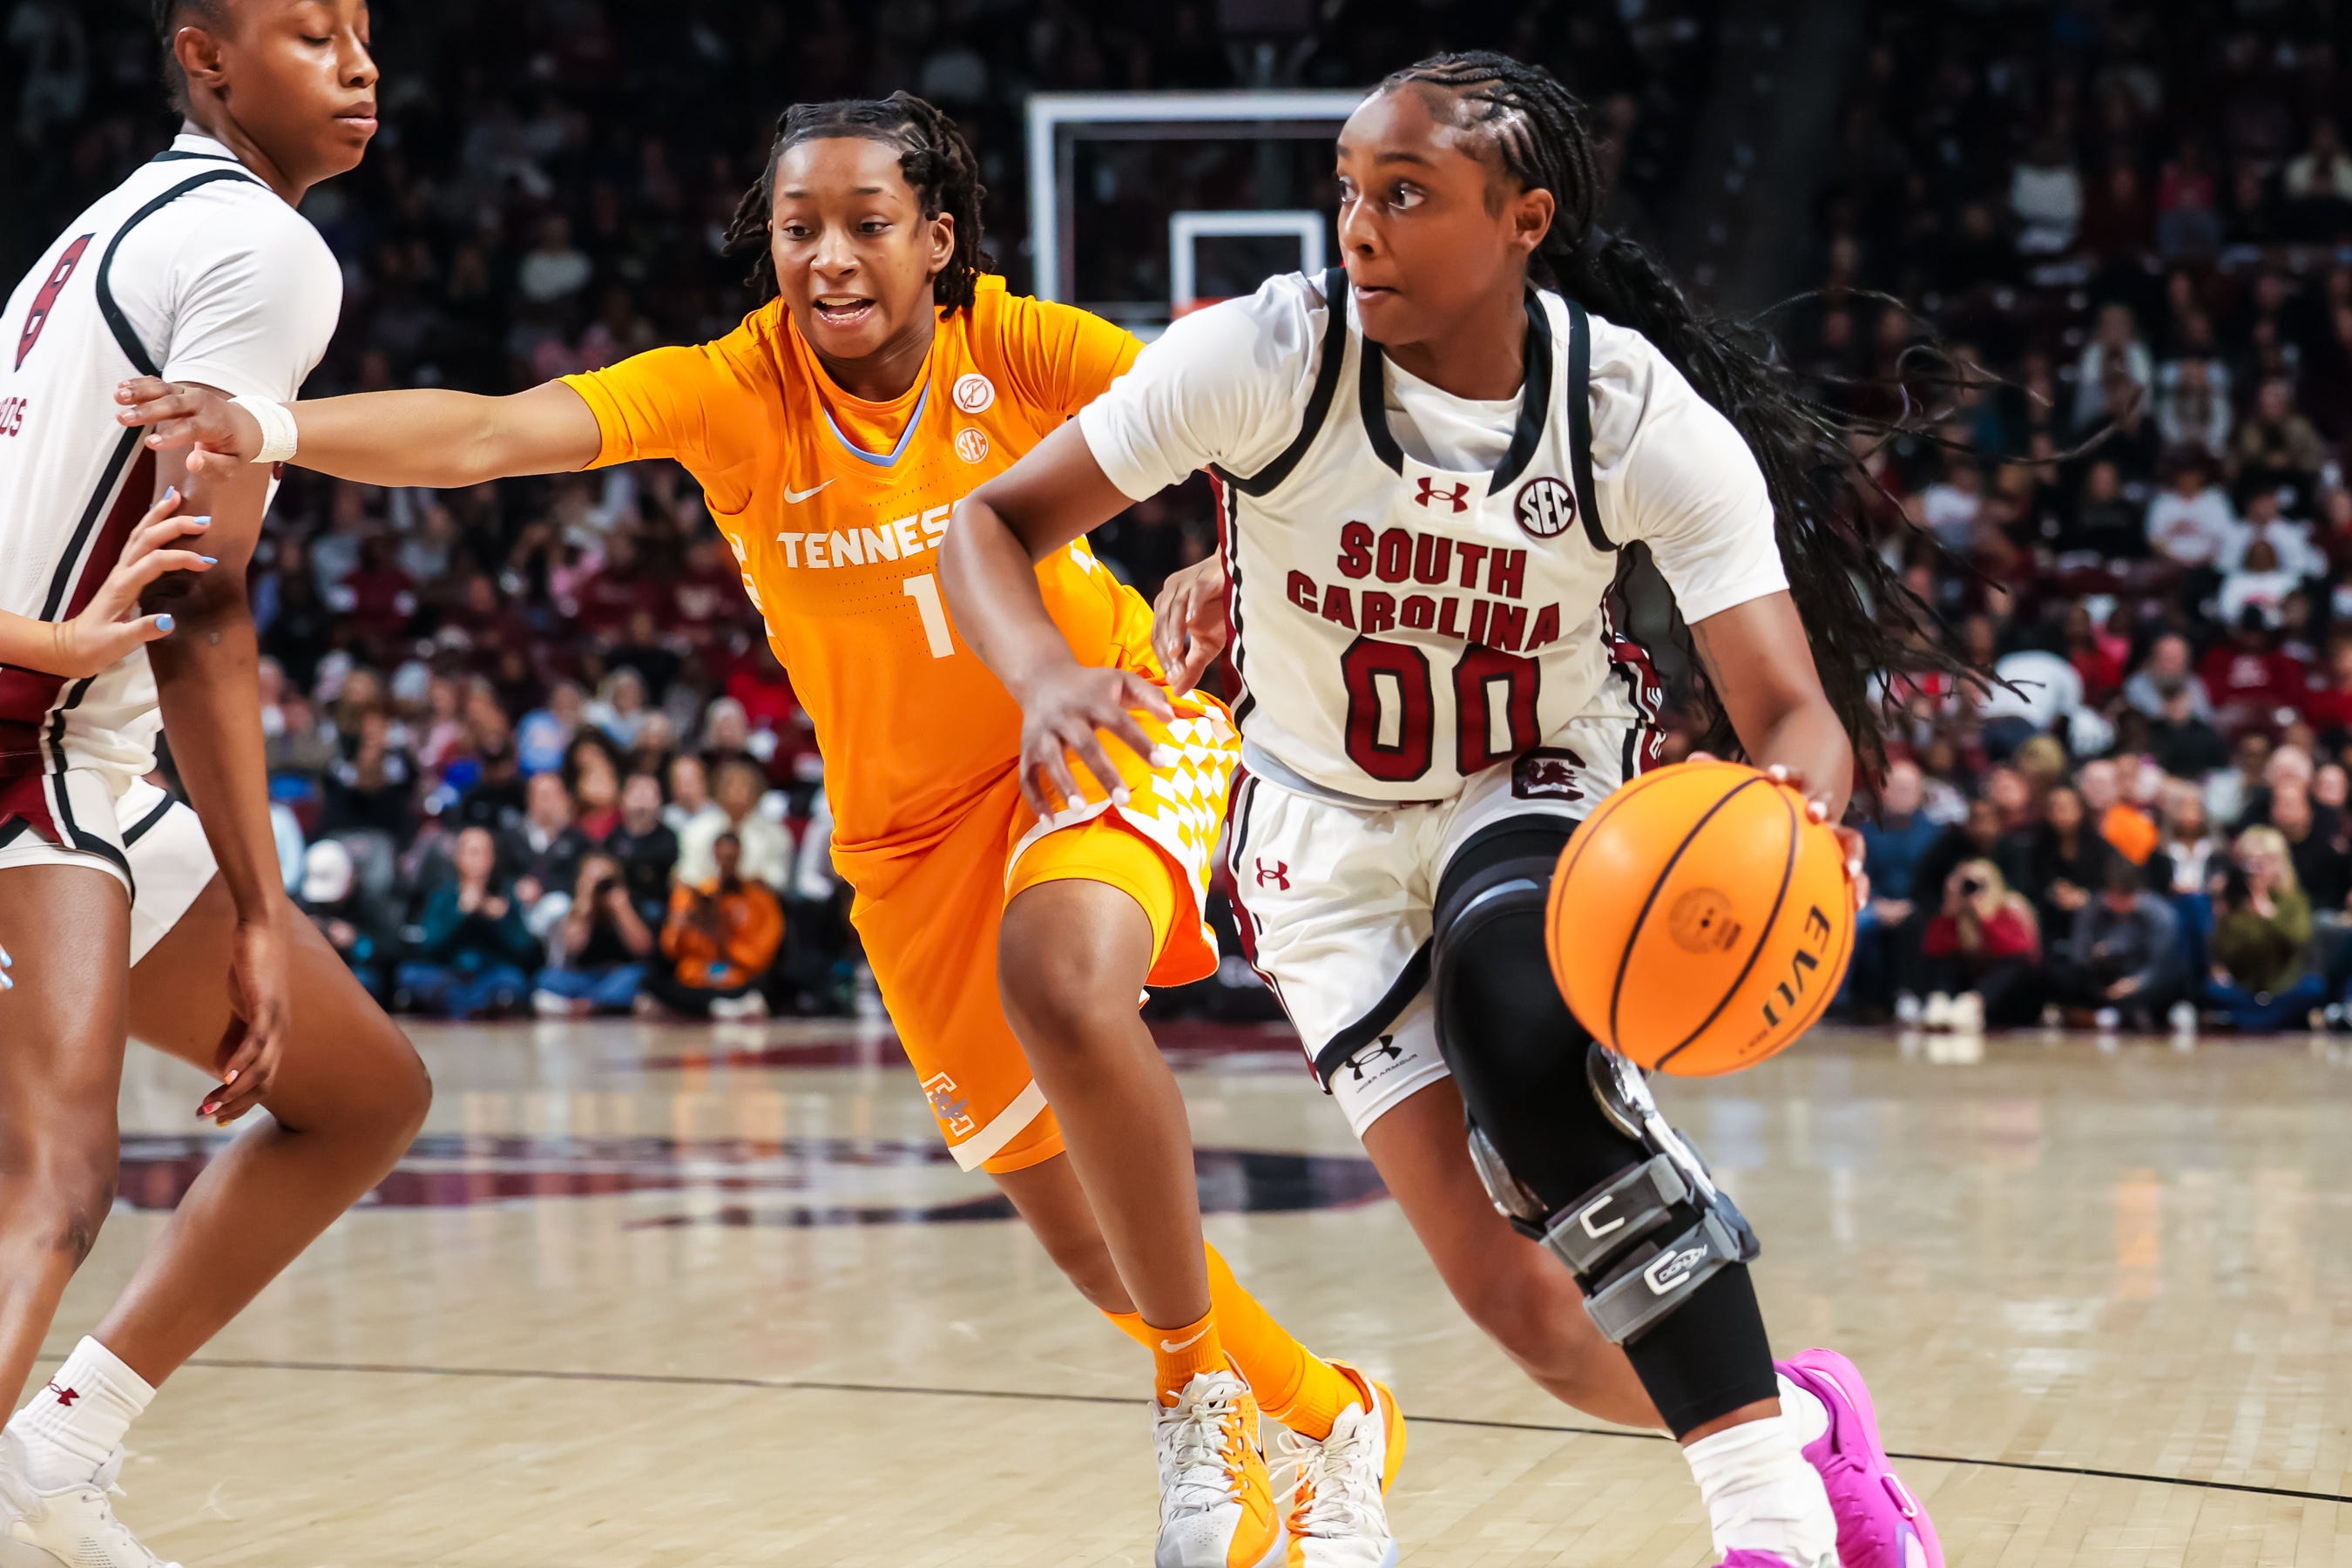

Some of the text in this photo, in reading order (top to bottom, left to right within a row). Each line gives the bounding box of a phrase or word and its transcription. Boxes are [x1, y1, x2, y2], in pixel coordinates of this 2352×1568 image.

[15, 232, 97, 373] 8
[957, 429, 987, 461] SEC
[775, 497, 964, 569] TENNES
[1518, 479, 1572, 535] SEC
[1336, 520, 1528, 600] SOUTH
[902, 572, 956, 659] 1
[1286, 569, 1560, 653] CAROLINA
[1340, 634, 1541, 783] 00
[1379, 1052, 1418, 1077] ARMOUR
